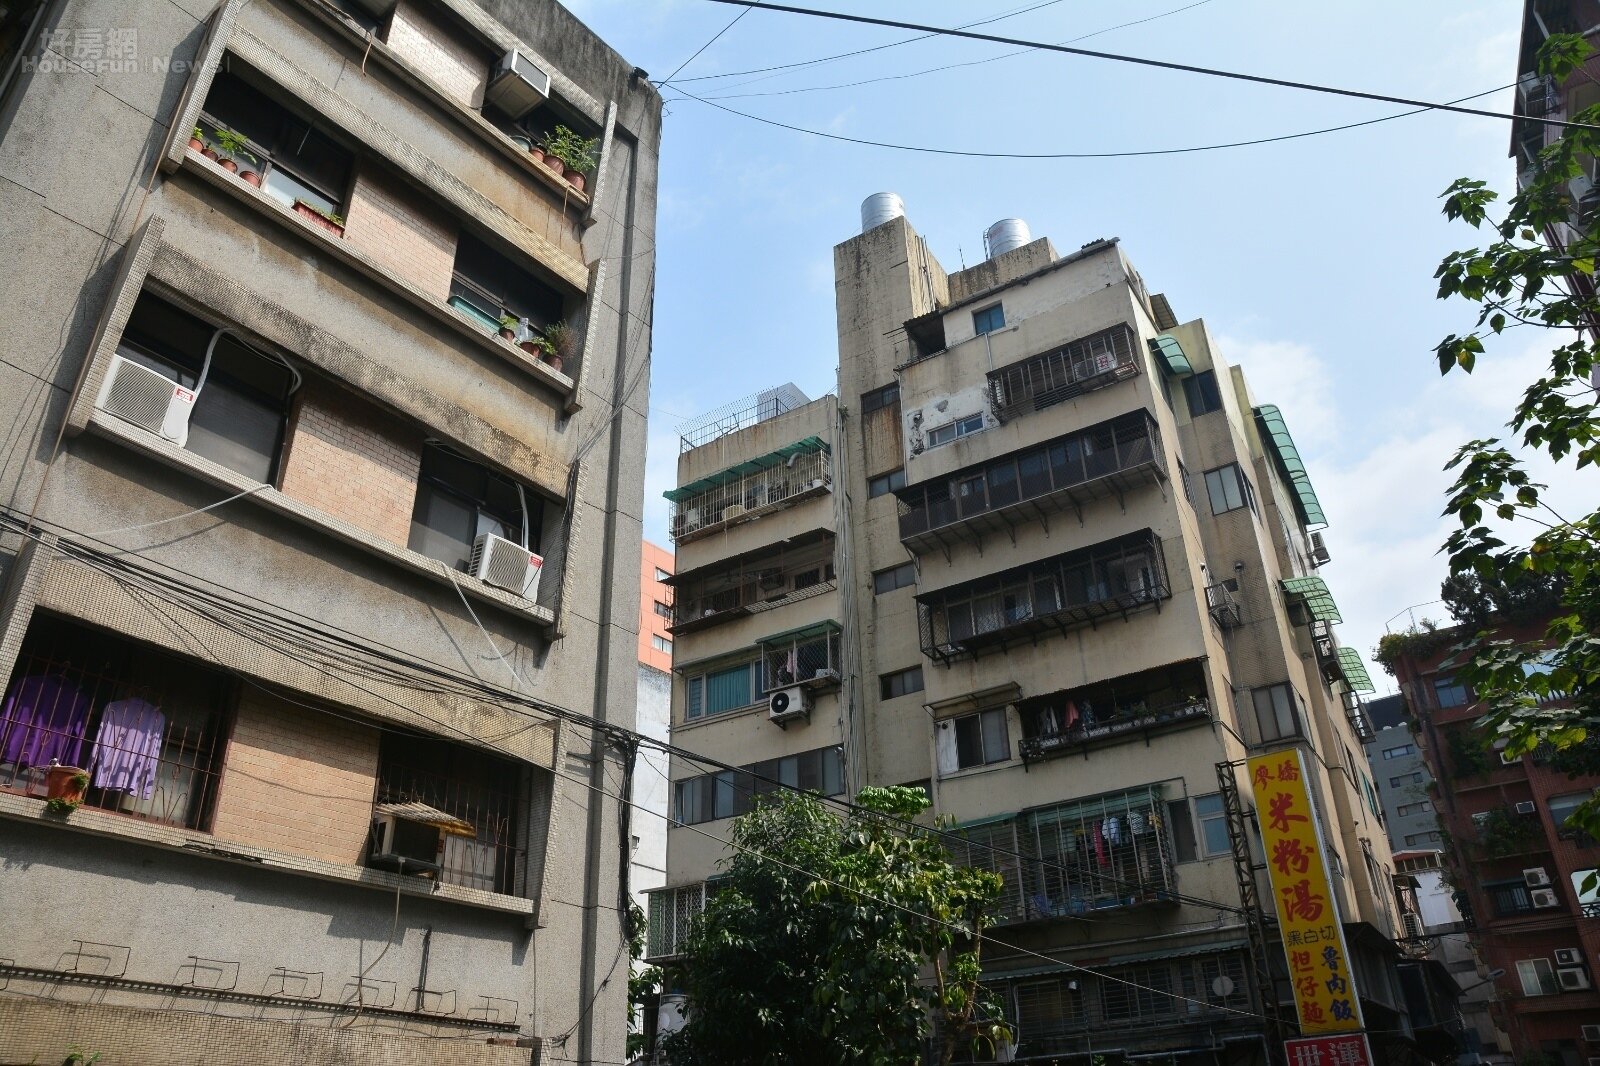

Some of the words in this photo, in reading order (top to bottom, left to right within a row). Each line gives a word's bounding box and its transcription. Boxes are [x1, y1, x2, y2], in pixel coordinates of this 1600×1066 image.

[1269, 792, 1325, 922] 米粉湯
[1287, 926, 1335, 947] 黑白切
[1321, 945, 1356, 1021] 魯肉飯
